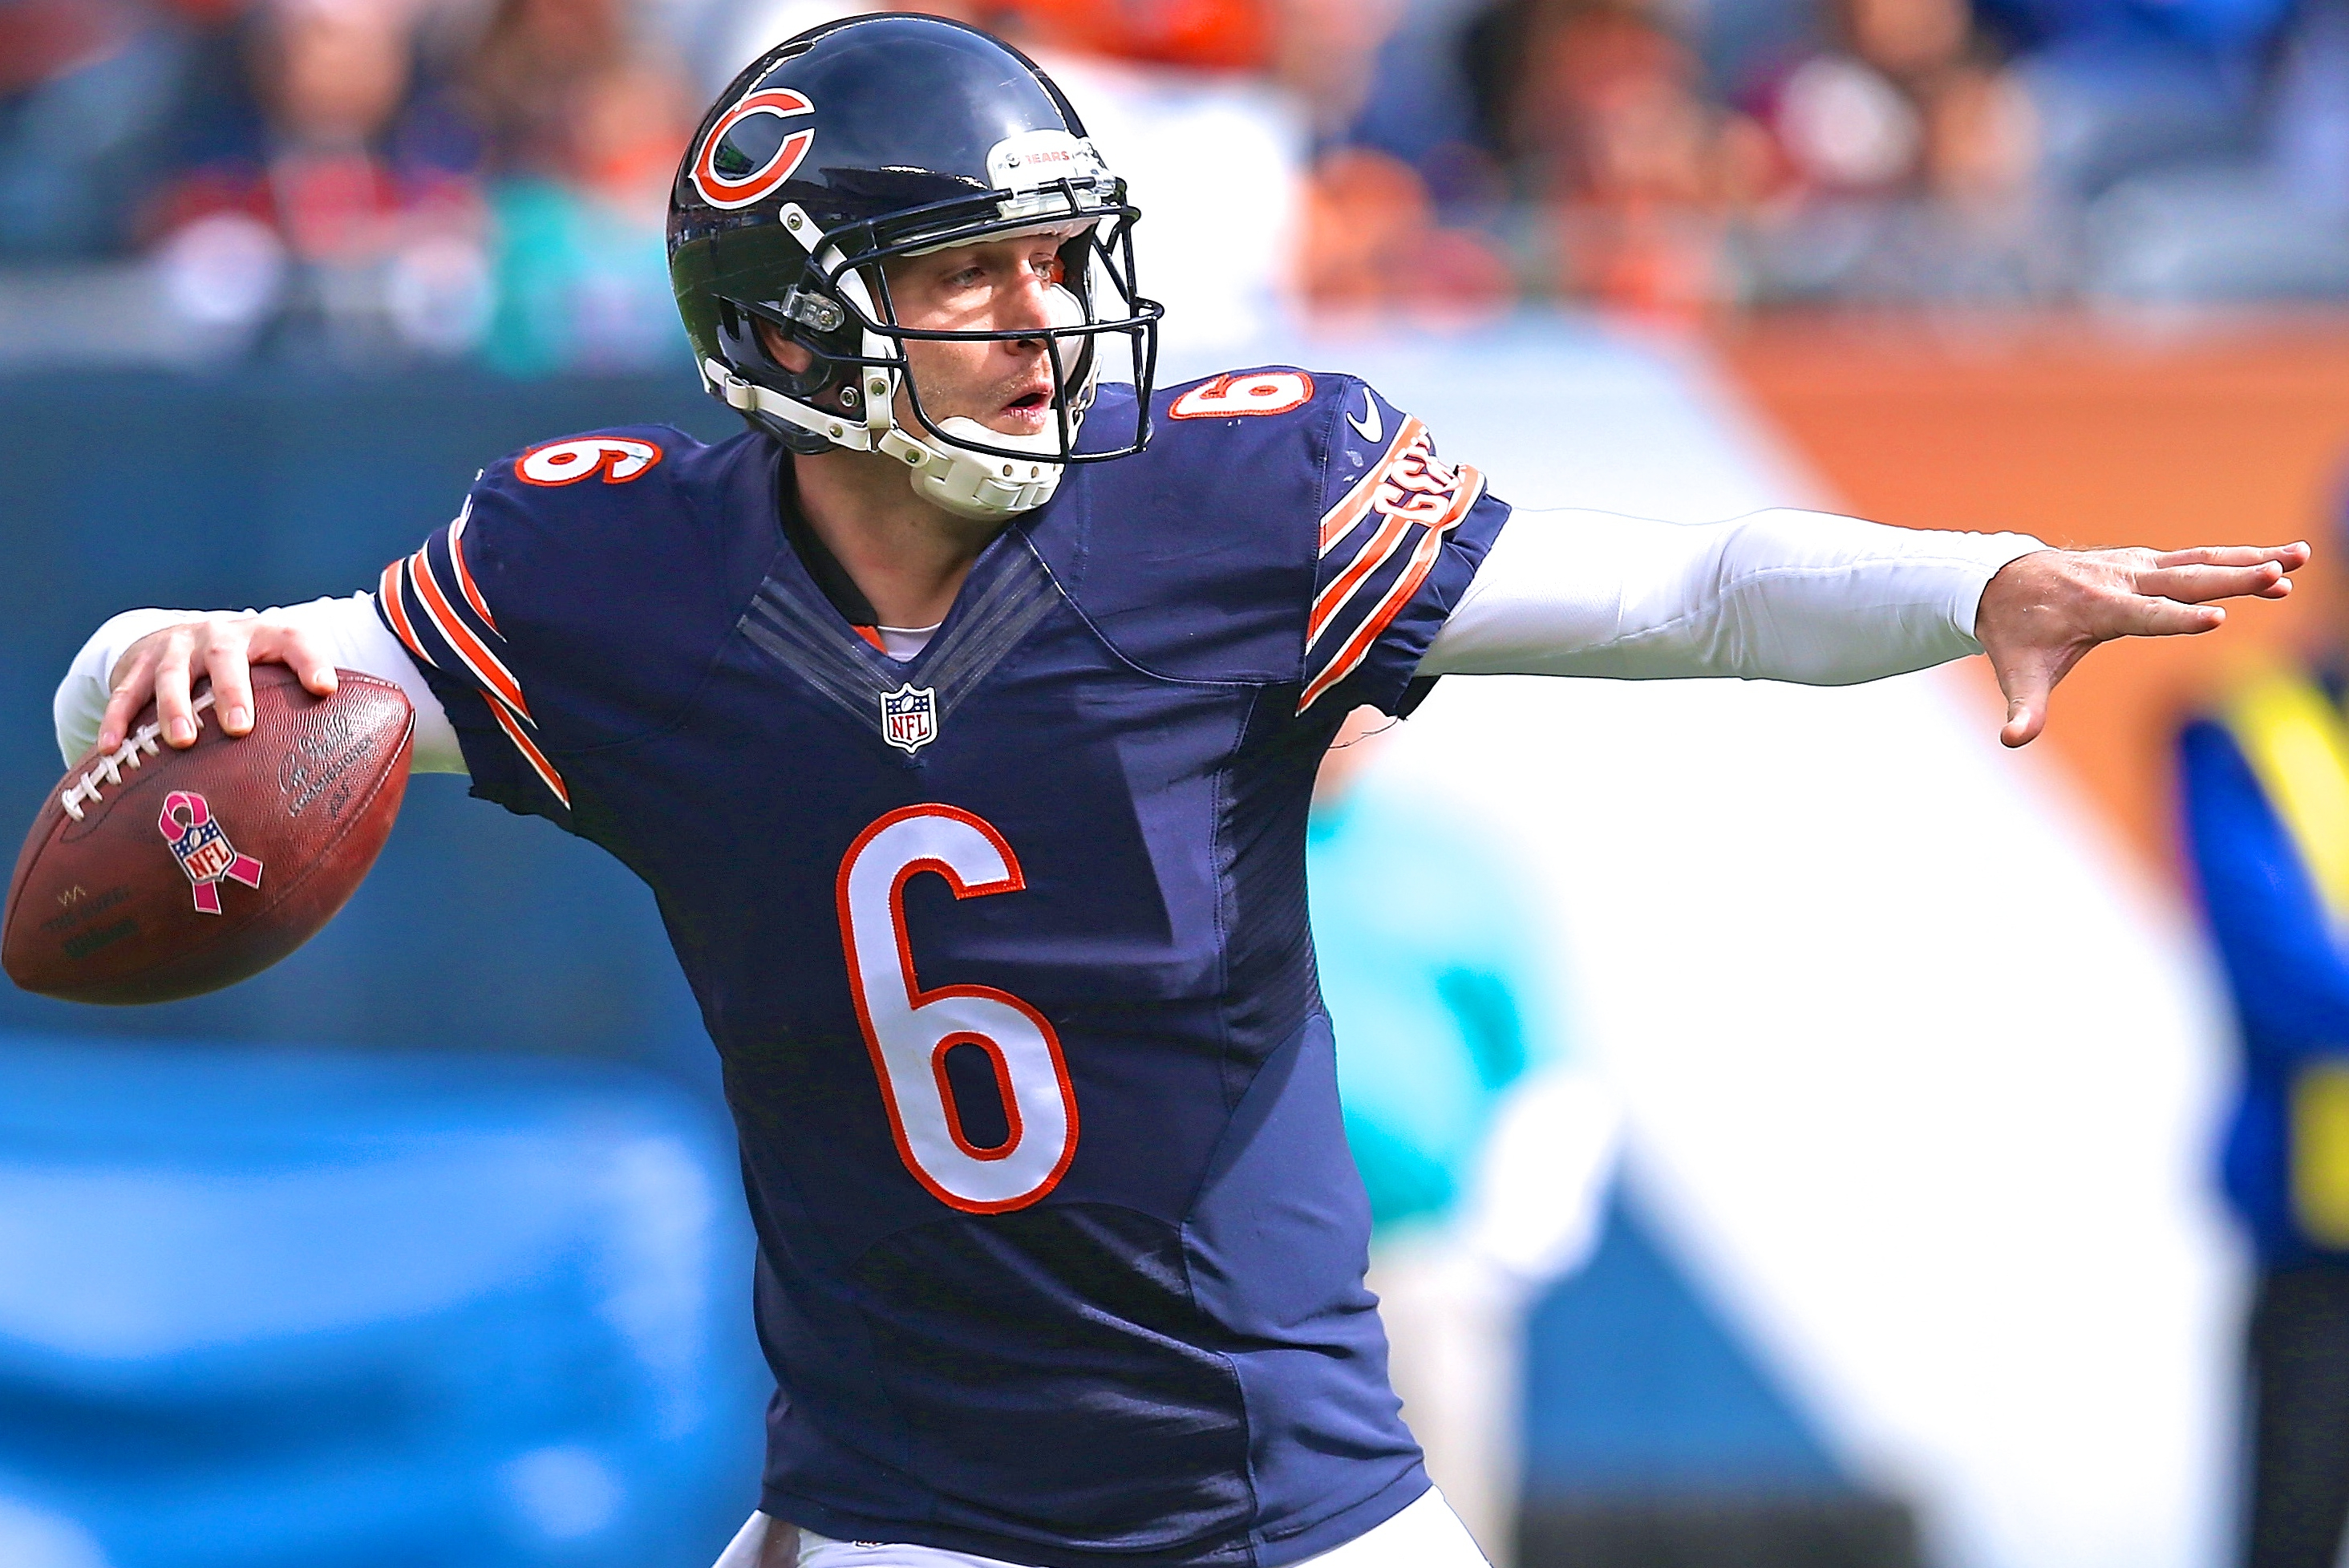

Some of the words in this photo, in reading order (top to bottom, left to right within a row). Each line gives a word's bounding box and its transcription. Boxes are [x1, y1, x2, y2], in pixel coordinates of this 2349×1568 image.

[687, 87, 816, 209] C
[1168, 372, 1315, 419] 6
[514, 435, 662, 488] 6
[891, 714, 928, 741] NFL
[185, 841, 231, 879] NFL
[836, 803, 1079, 1215] 6
